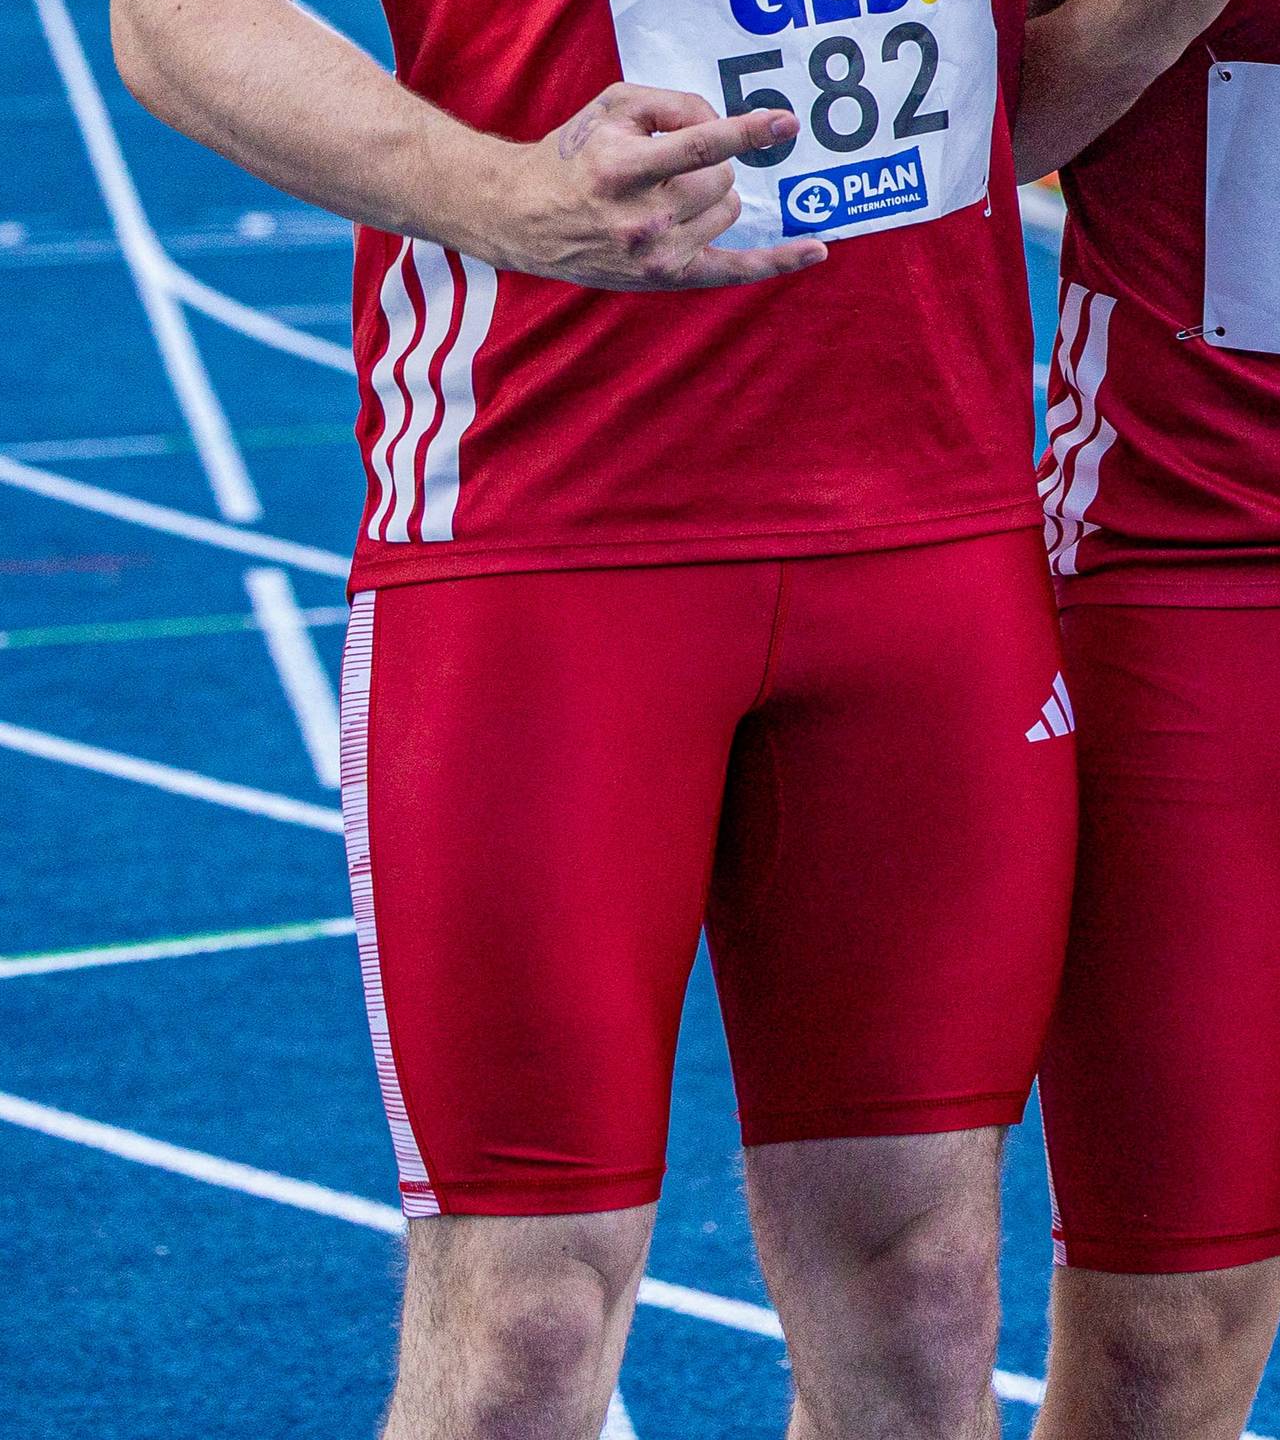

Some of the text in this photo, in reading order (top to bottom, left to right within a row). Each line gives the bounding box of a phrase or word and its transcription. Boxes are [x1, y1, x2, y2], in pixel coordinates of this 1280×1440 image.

[717, 21, 949, 168] 582
[843, 162, 919, 202] PLAN
[847, 192, 922, 217] INTERNATIONAL
